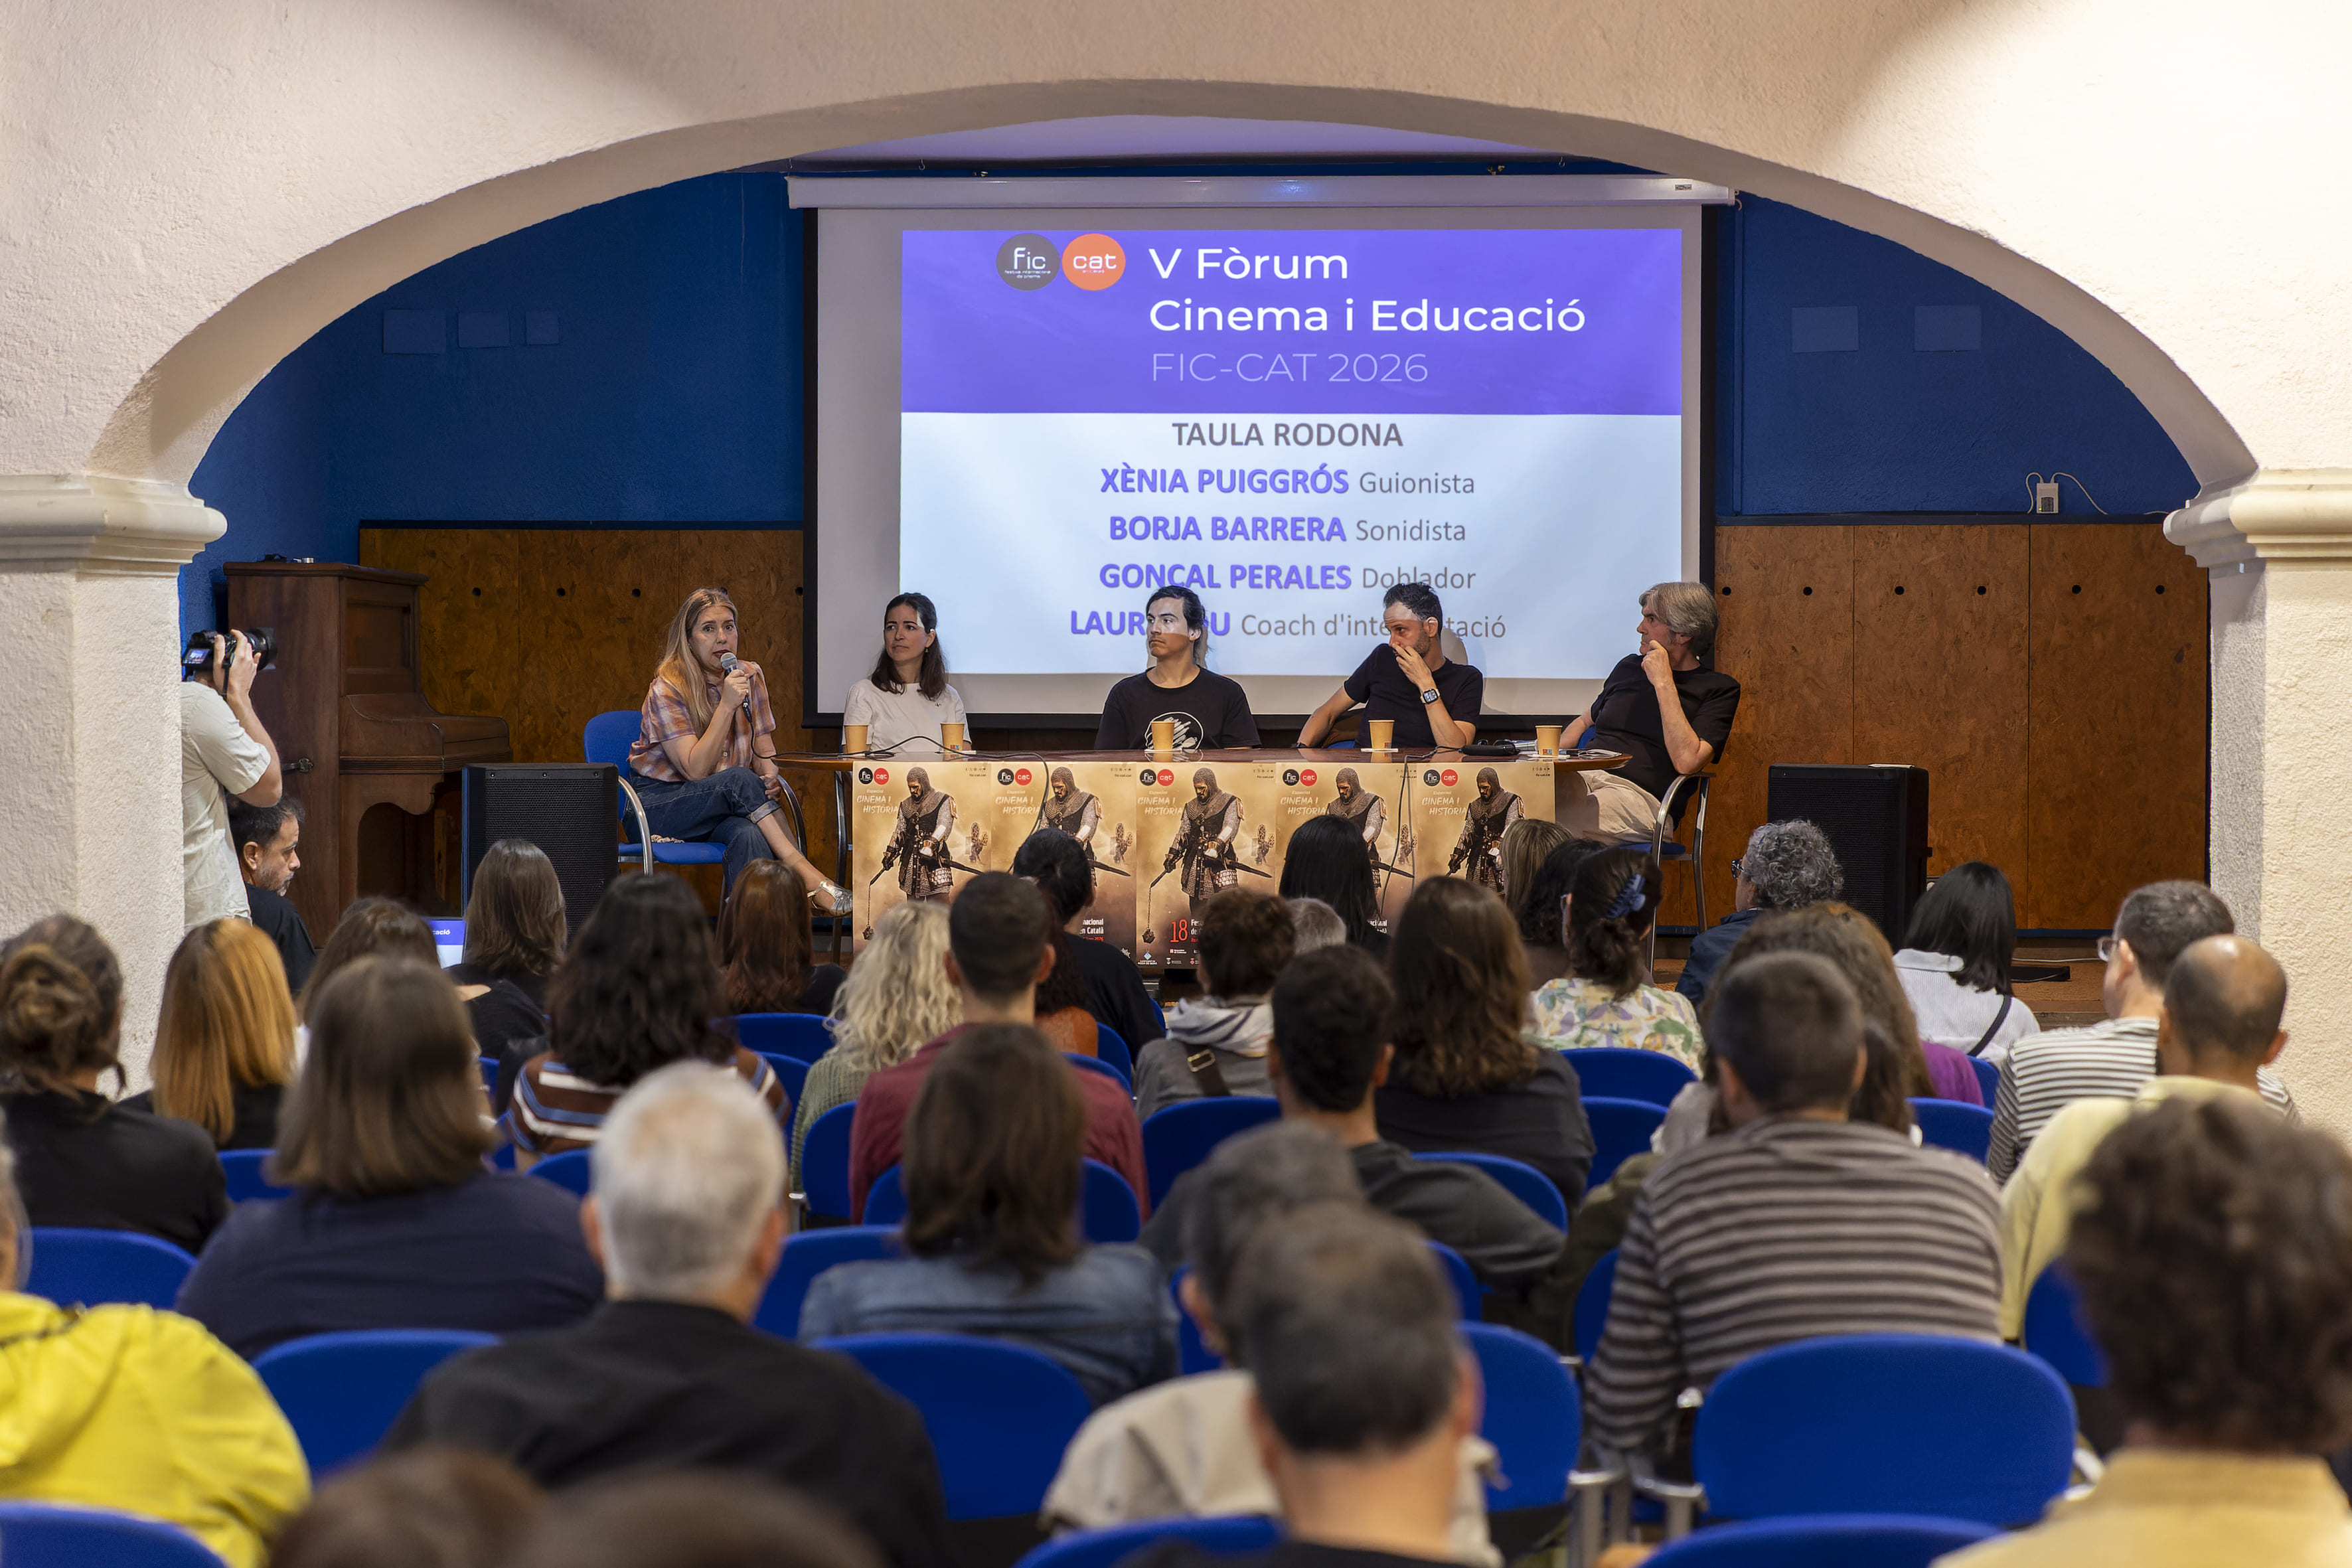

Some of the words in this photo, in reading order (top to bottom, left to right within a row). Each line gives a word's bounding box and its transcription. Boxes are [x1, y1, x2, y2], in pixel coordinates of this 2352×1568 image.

[1014, 247, 1046, 270] fic
[1073, 253, 1117, 270] cat
[1149, 249, 1182, 279] V
[1198, 247, 1348, 279] Fòrum
[1150, 298, 1328, 331] Cinema
[1346, 297, 1354, 331] i
[1372, 298, 1585, 332] Educació
[1152, 353, 1316, 382] FIC-CAT
[1328, 353, 1429, 382] 2026
[1172, 422, 1264, 447] TAULA
[1274, 422, 1404, 447] RODONA
[1101, 461, 1189, 493] XÈNIA
[1198, 463, 1350, 495] PUIGGRÓS
[1359, 471, 1475, 494] Guionista
[1110, 516, 1203, 541] BORJA
[1211, 516, 1347, 542] BARRERA
[1356, 518, 1466, 541] Sonidista
[1231, 565, 1352, 589] PERALES
[1363, 566, 1476, 589] Doblador
[1071, 611, 1146, 636] LAUR
[1242, 613, 1315, 637] Coach
[862, 771, 871, 779] fic
[1137, 797, 1170, 805] CINEMA
[1280, 797, 1313, 805] CINEMA
[1421, 797, 1454, 805] CINEMA
[1170, 919, 1188, 943] 18
